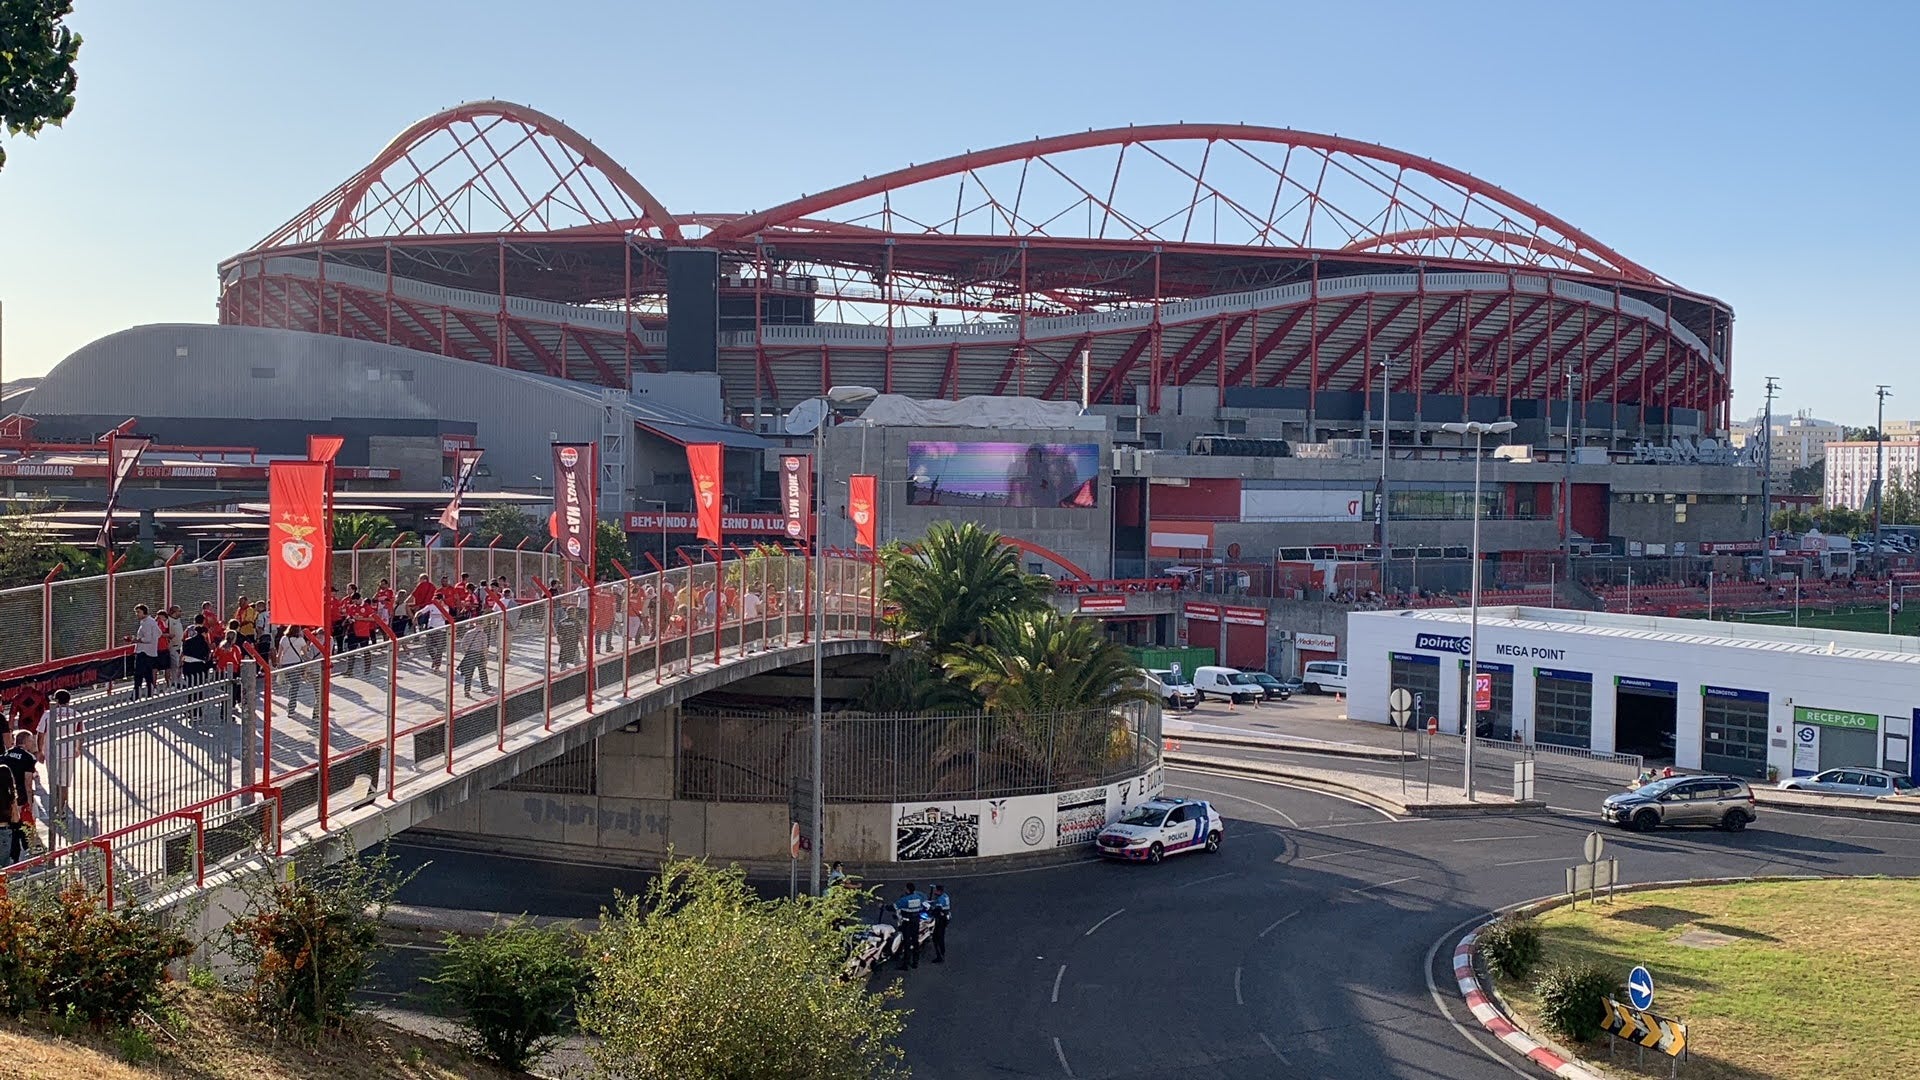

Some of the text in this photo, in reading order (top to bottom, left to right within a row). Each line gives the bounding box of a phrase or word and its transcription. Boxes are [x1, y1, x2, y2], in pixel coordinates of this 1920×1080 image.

[631, 516, 687, 528] BEM-VNDO
[751, 518, 764, 529] DA
[767, 518, 785, 530] LUZ
[1420, 635, 1455, 649] point
[1496, 644, 1566, 661] MEGA POINT
[1173, 664, 1179, 674] P
[1476, 679, 1489, 691] P2
[1806, 711, 1866, 726] RECEPÇÃO
